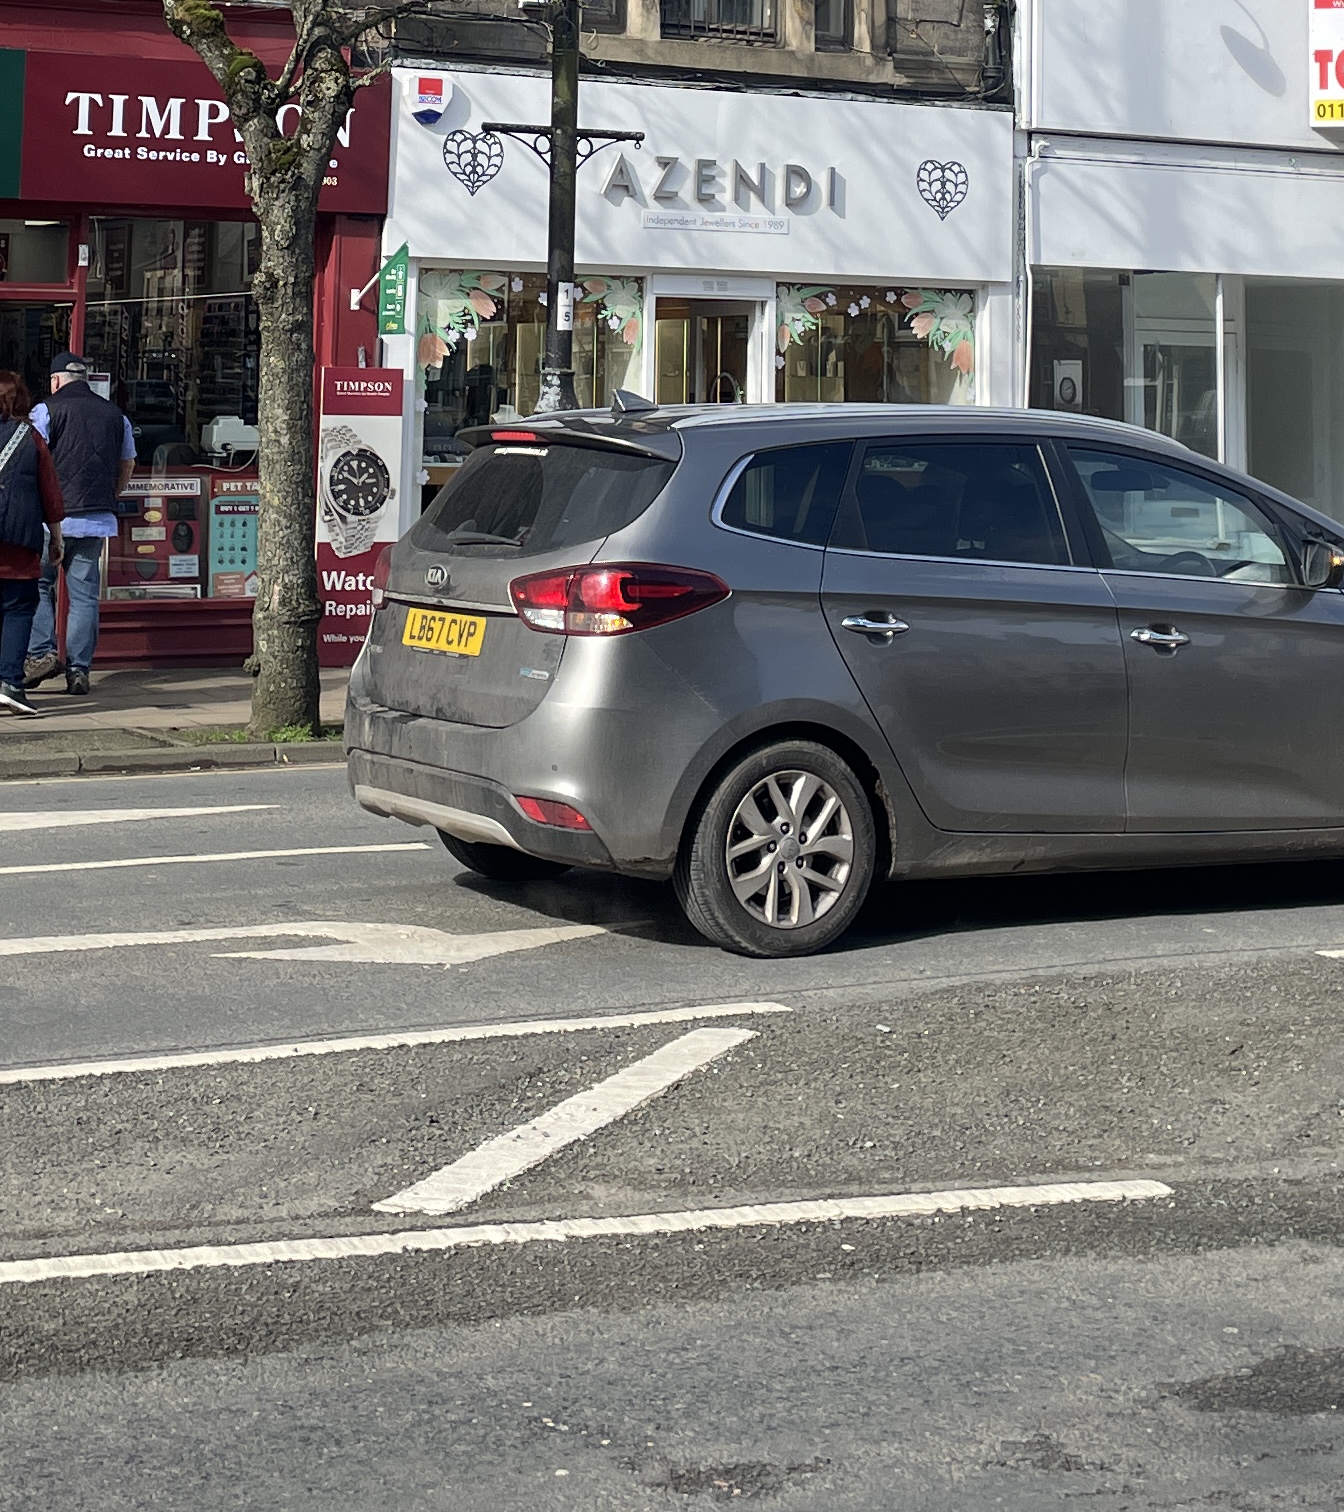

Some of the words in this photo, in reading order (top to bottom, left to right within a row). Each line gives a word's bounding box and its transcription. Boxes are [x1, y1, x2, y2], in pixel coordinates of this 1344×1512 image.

[64, 91, 356, 148] TIMPO
[83, 144, 131, 159] Great
[137, 146, 200, 163] Service
[207, 150, 227, 166] By
[600, 152, 837, 208] AZENDI
[646, 215, 697, 226] Independent
[700, 217, 736, 228] Jewellers
[738, 219, 760, 229] Since
[763, 220, 785, 230] 1989
[564, 289, 569, 299] 1
[564, 312, 571, 322] 5
[334, 381, 393, 392] TIMPSON
[123, 482, 195, 492] MMEMORATIVE
[222, 482, 243, 492] PET
[321, 570, 375, 591] Watc
[428, 568, 442, 583] KIA
[409, 613, 445, 643] LB67
[445, 619, 478, 648] CVP
[322, 633, 347, 643] While
[348, 635, 365, 644] you
